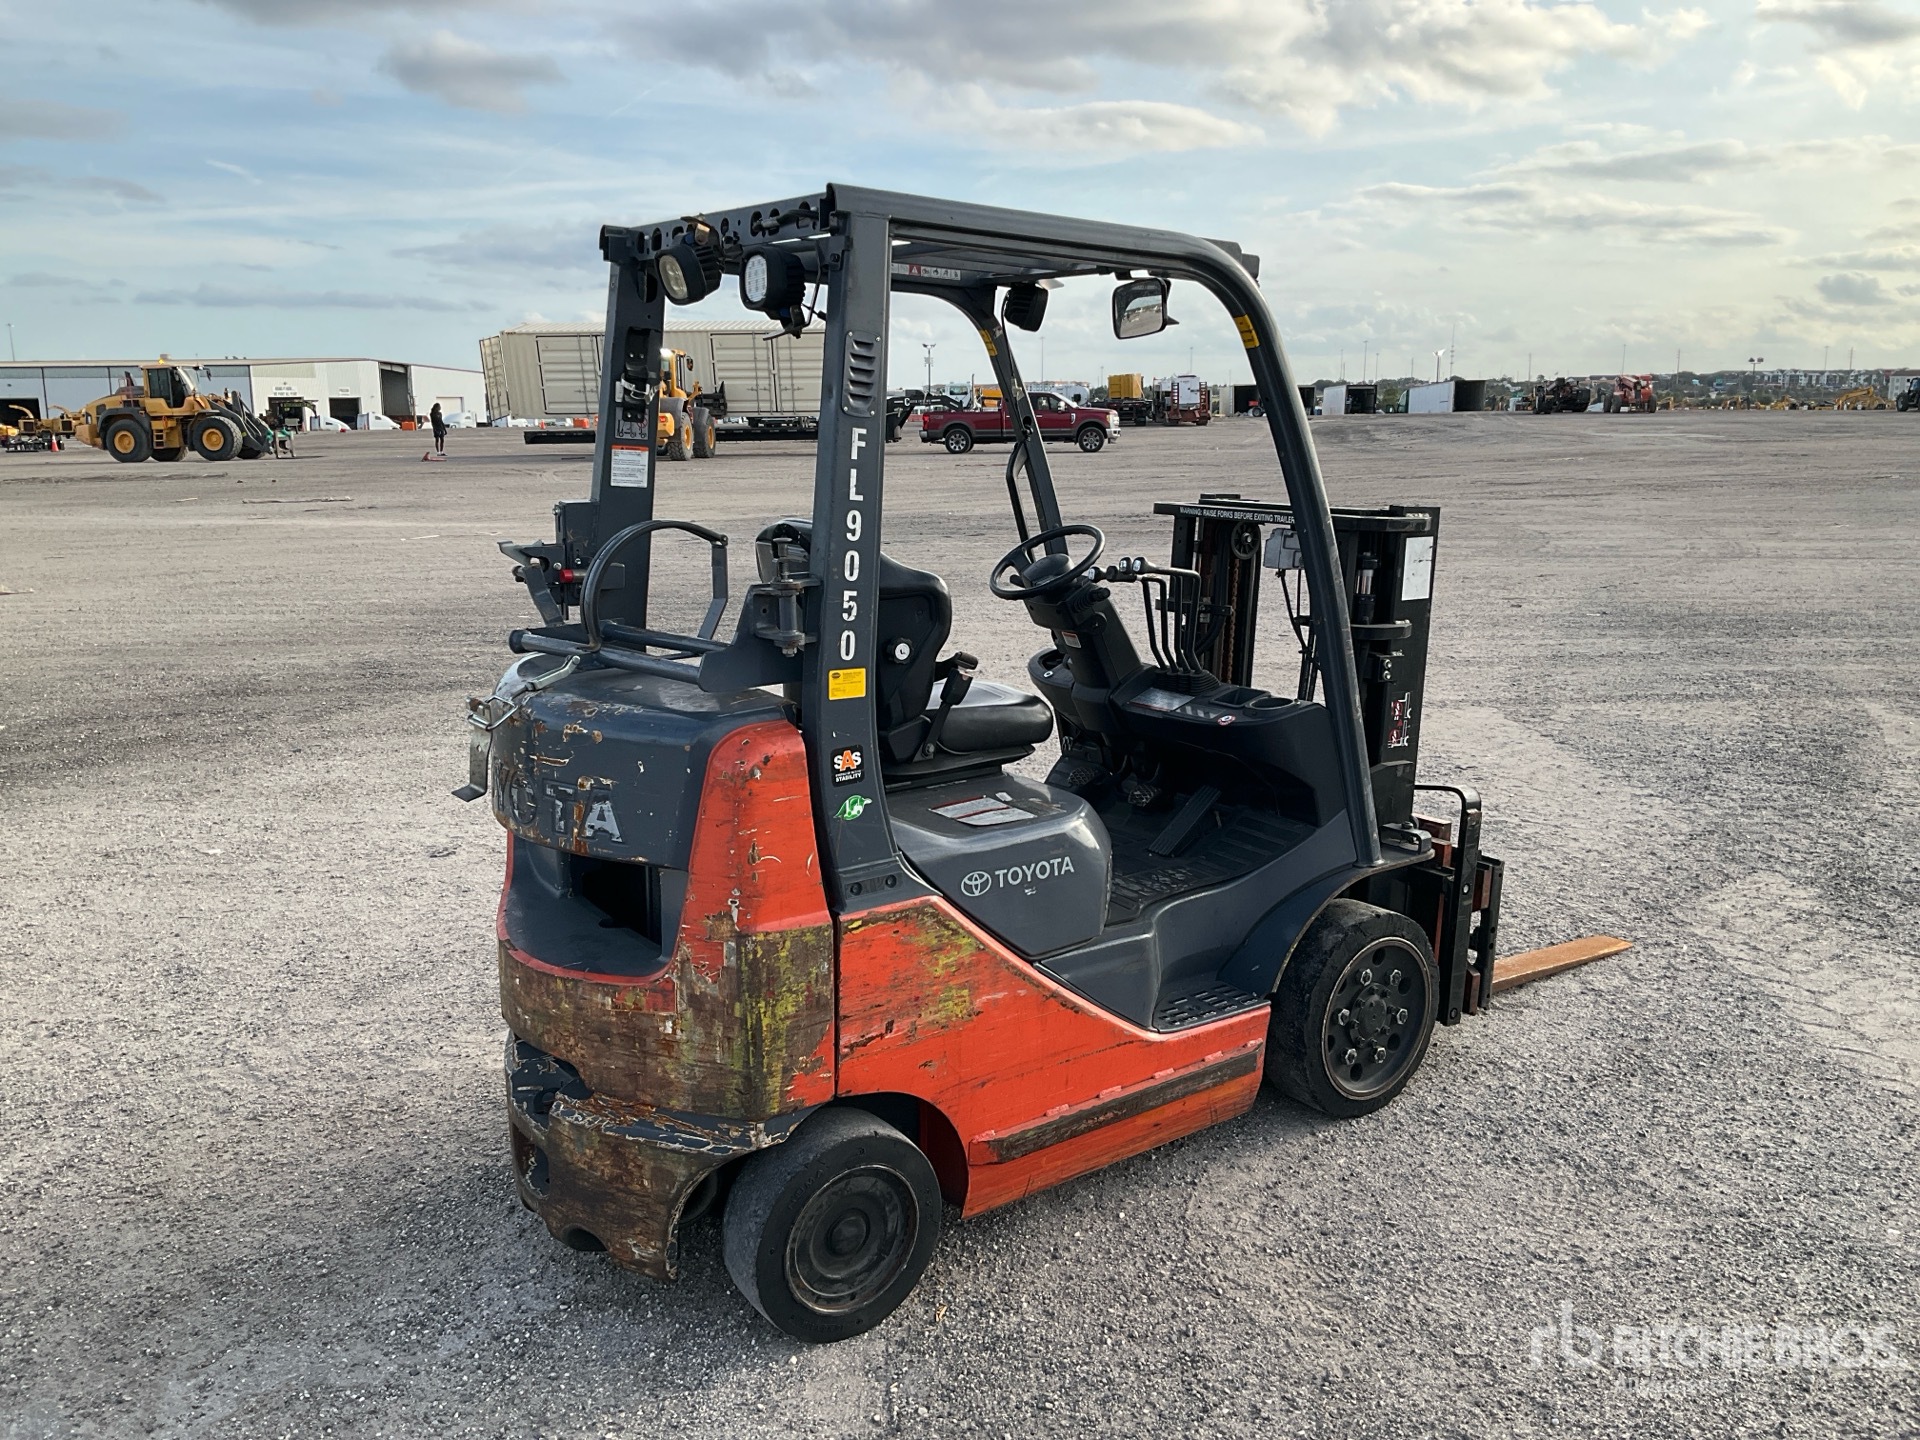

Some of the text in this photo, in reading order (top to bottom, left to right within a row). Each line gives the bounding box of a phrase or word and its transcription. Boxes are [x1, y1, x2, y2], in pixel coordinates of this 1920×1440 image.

[1203, 508, 1217, 518] RAISE
[1217, 510, 1233, 519] FORKS
[1233, 511, 1253, 520] BEFORE
[840, 427, 868, 661] FL9050
[833, 750, 862, 772] SAS
[835, 772, 862, 783] STABILITY
[995, 856, 1075, 888] TOYOTA
